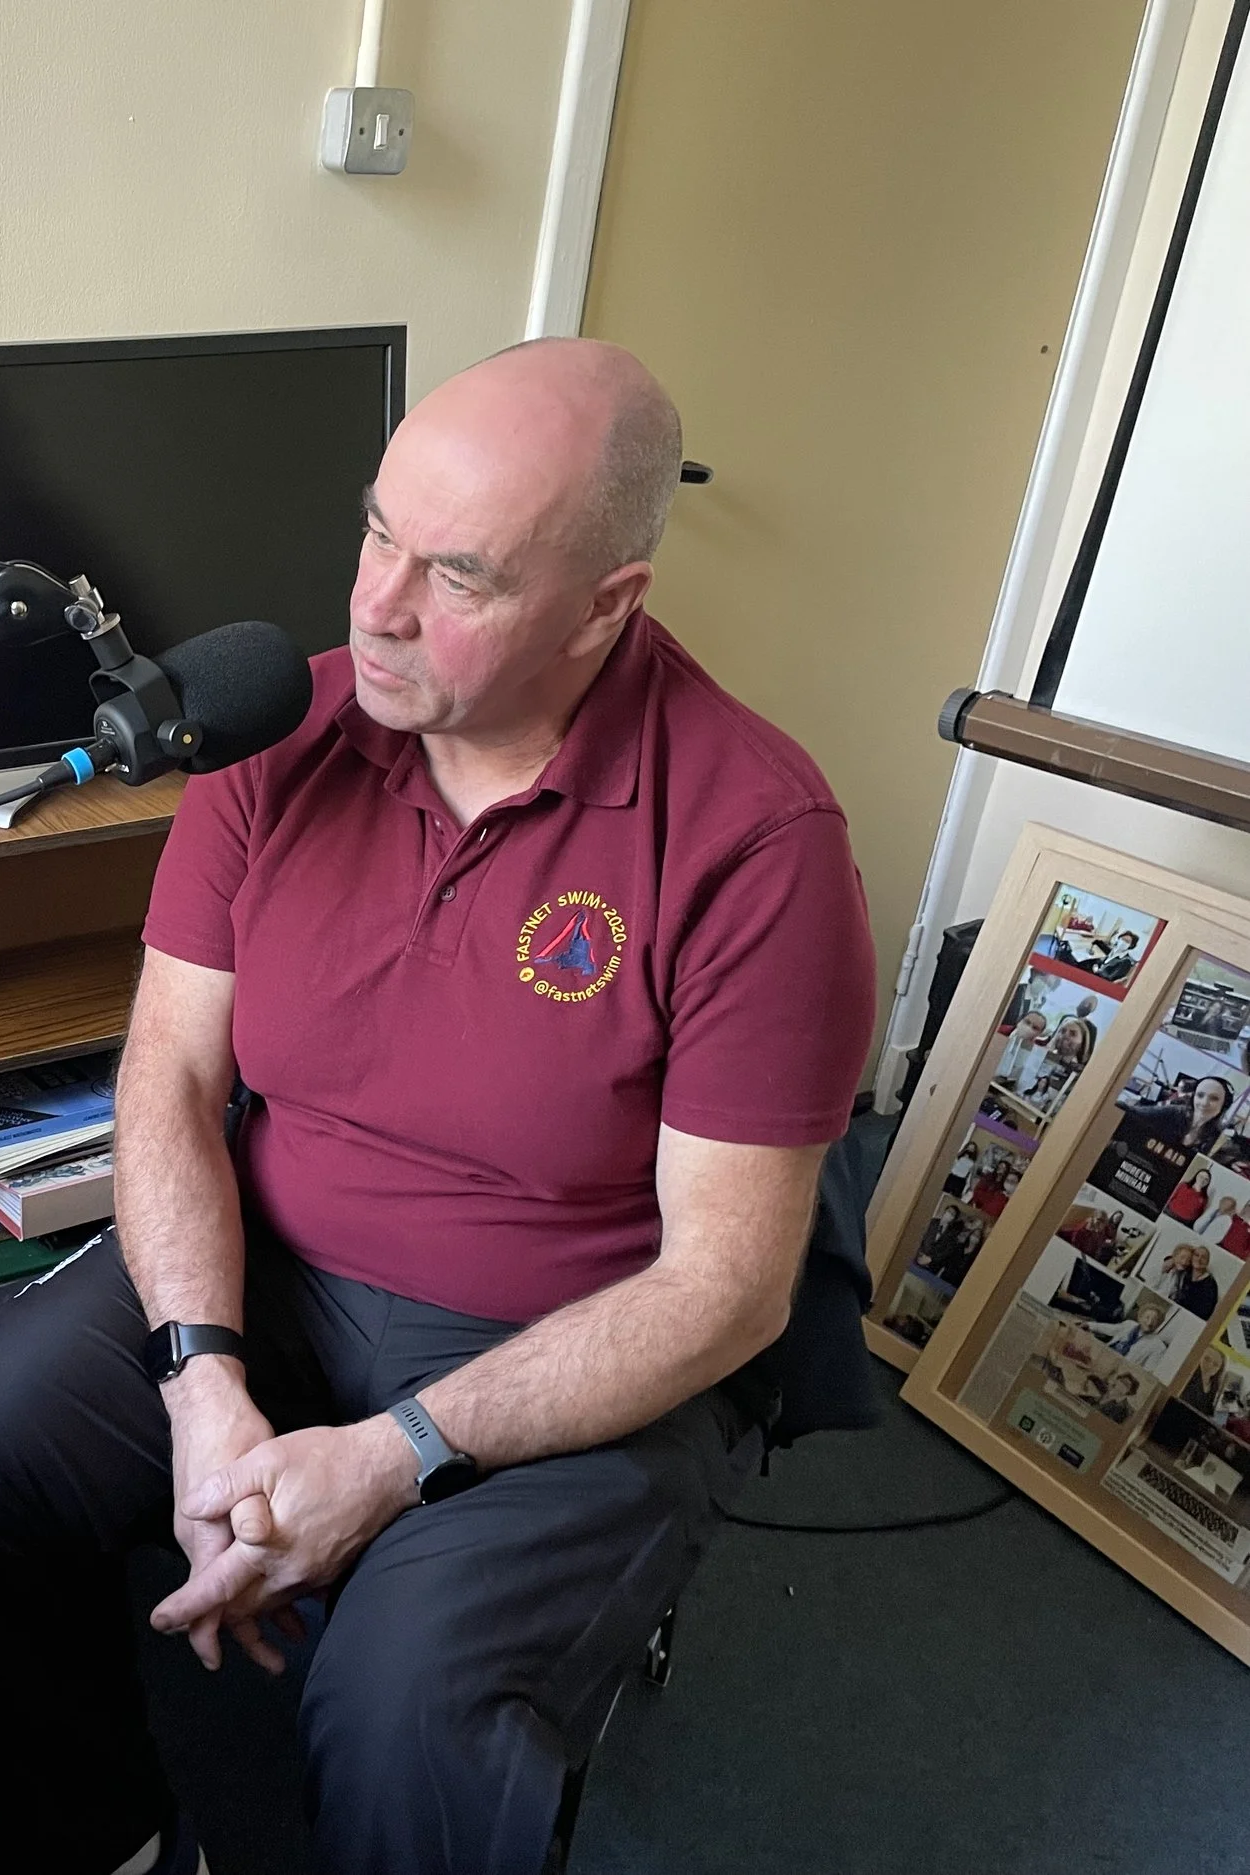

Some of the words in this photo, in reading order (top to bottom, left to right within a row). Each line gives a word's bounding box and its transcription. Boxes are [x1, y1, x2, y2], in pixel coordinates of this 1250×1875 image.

[516, 902, 552, 962] FASTNET
[557, 891, 601, 909] SWIM
[603, 908, 627, 943] 2020
[534, 955, 622, 1002] @fastnetswim
